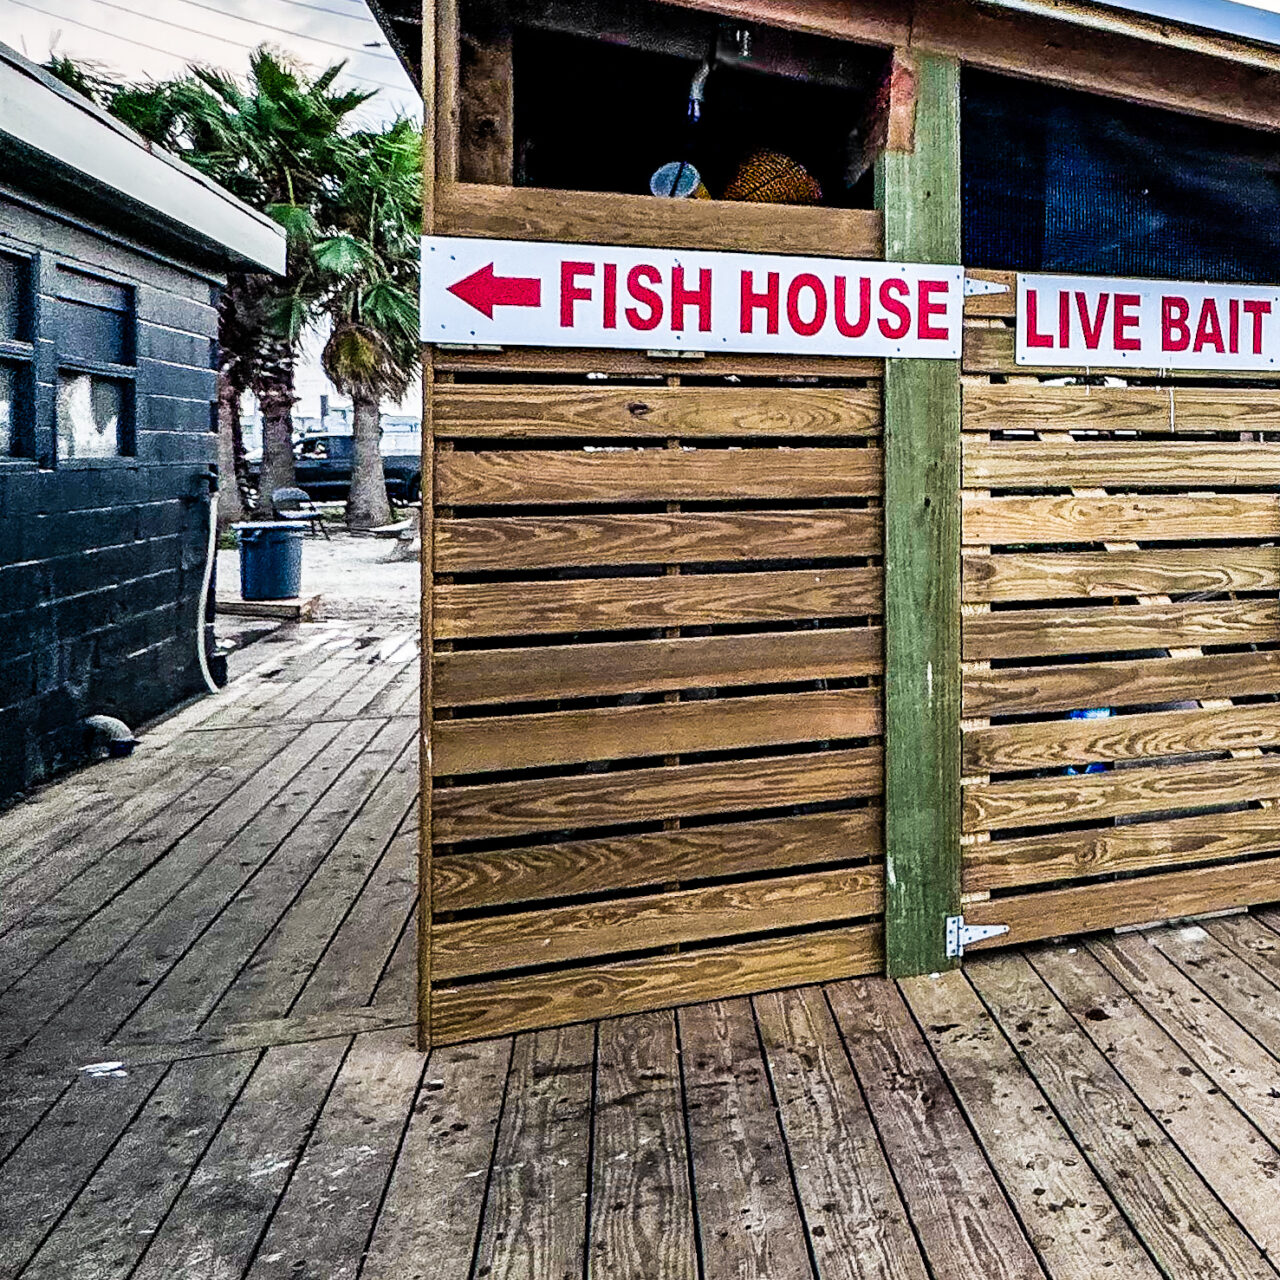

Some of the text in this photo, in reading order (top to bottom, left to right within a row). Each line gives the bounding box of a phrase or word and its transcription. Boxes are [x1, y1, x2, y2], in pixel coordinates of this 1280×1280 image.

[560, 261, 950, 341] FISH HOUSE
[1026, 289, 1273, 356] LIVE BAIT
